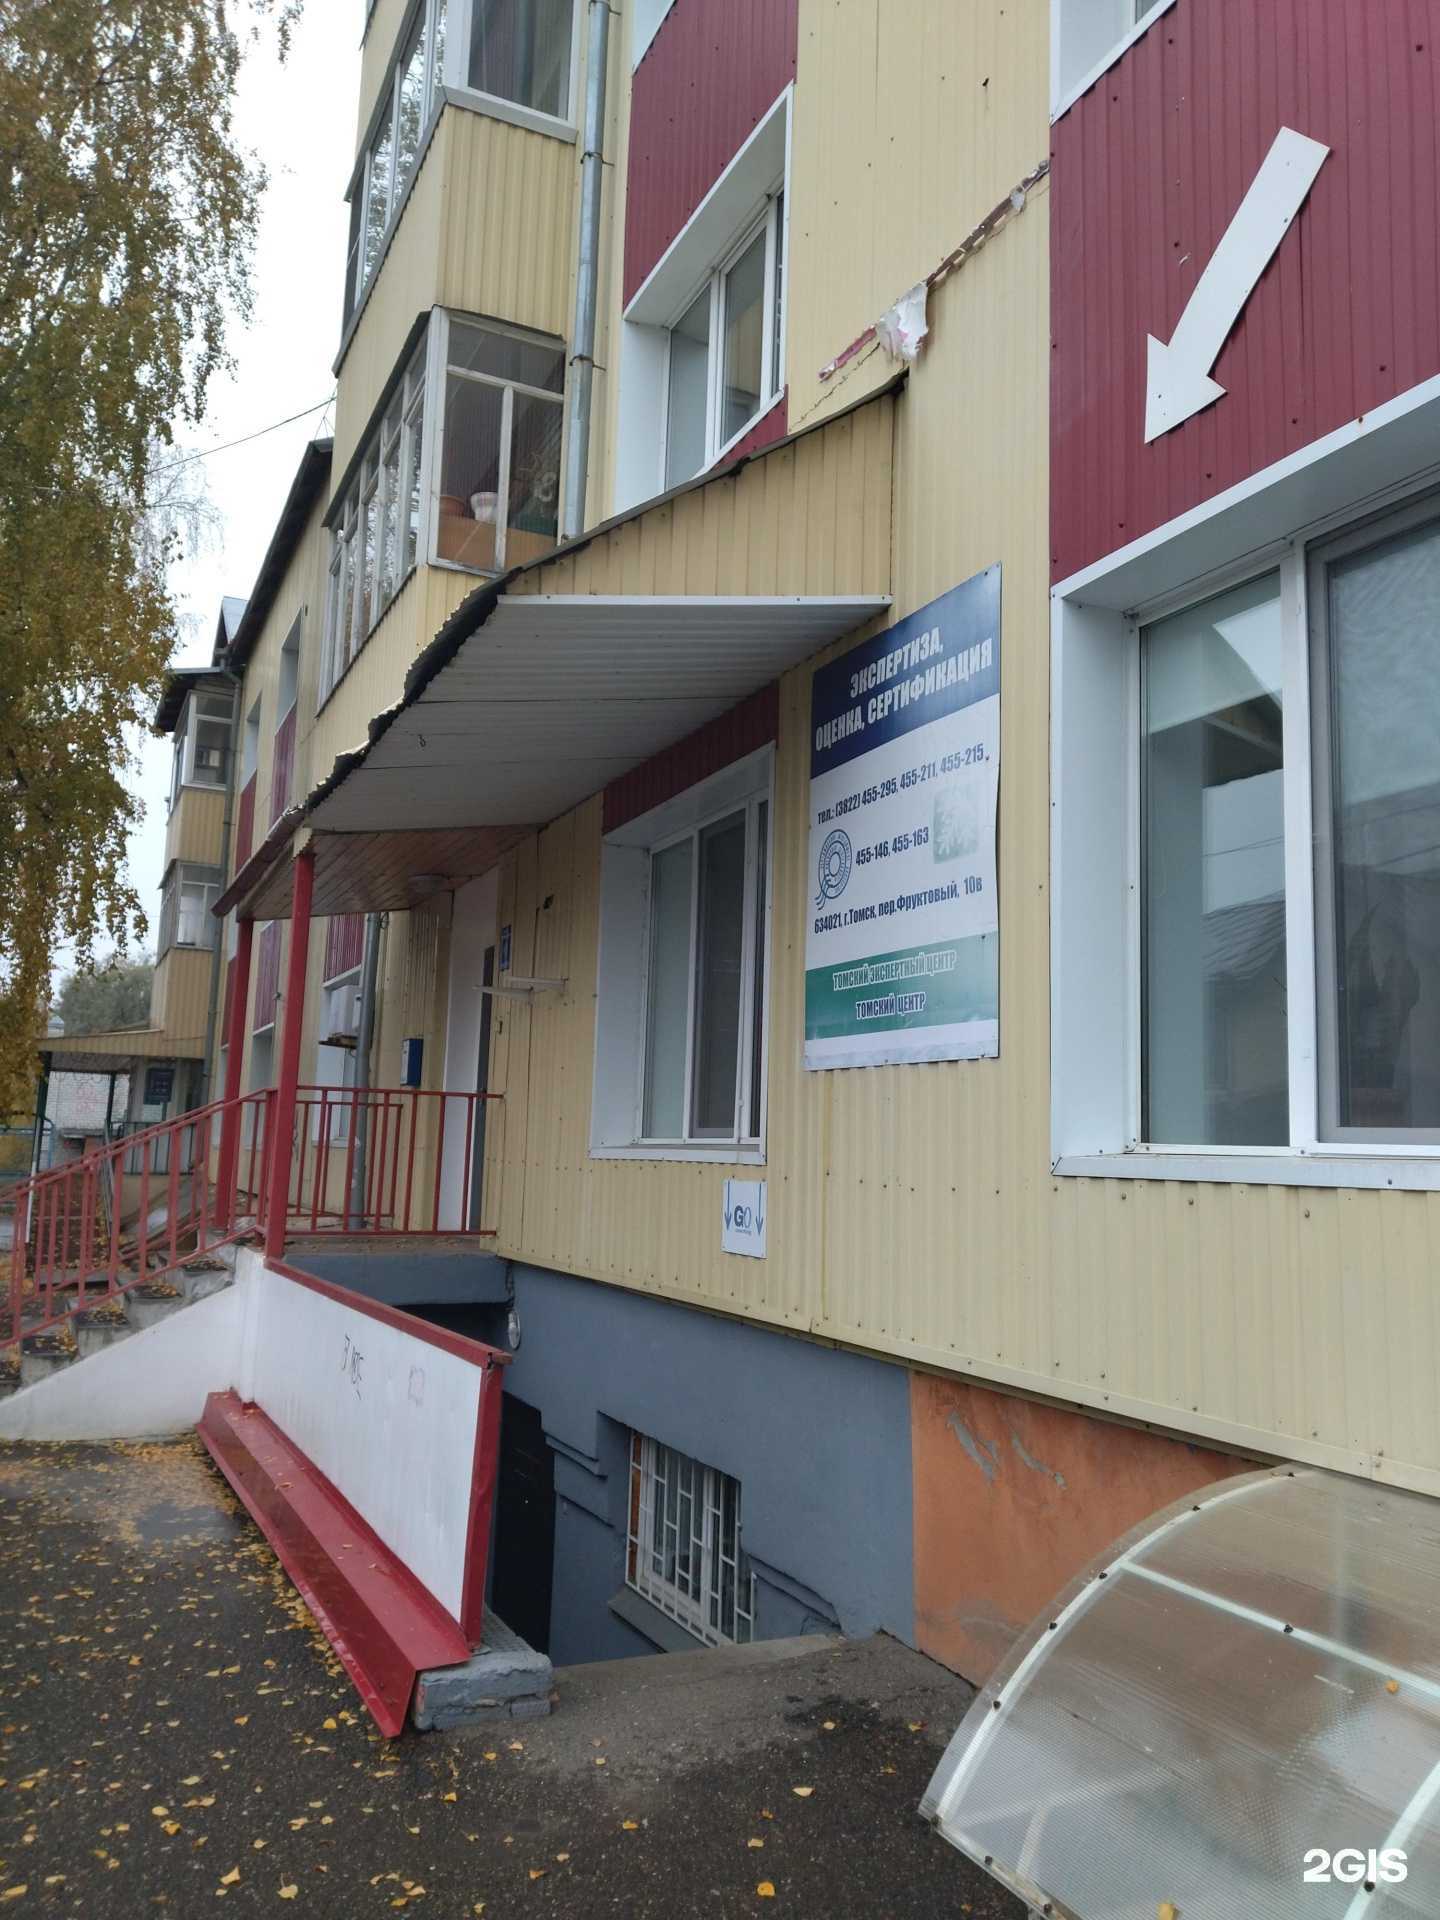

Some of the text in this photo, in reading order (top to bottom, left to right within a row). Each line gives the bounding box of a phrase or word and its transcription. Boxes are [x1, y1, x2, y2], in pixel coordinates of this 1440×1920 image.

[850, 627, 943, 698] ЭКСПЕРТИЗА,
[815, 638, 992, 751] ОЦЕНКА, СЕРТИФИКАЦИЯ
[892, 826, 929, 854] 455-163
[833, 949, 957, 991] ТОМСКИЙ ЭКСПЕРТНЫЙ ЦЕНТР
[856, 992, 927, 1020] ТОМСКИЙ ЦЕНТР
